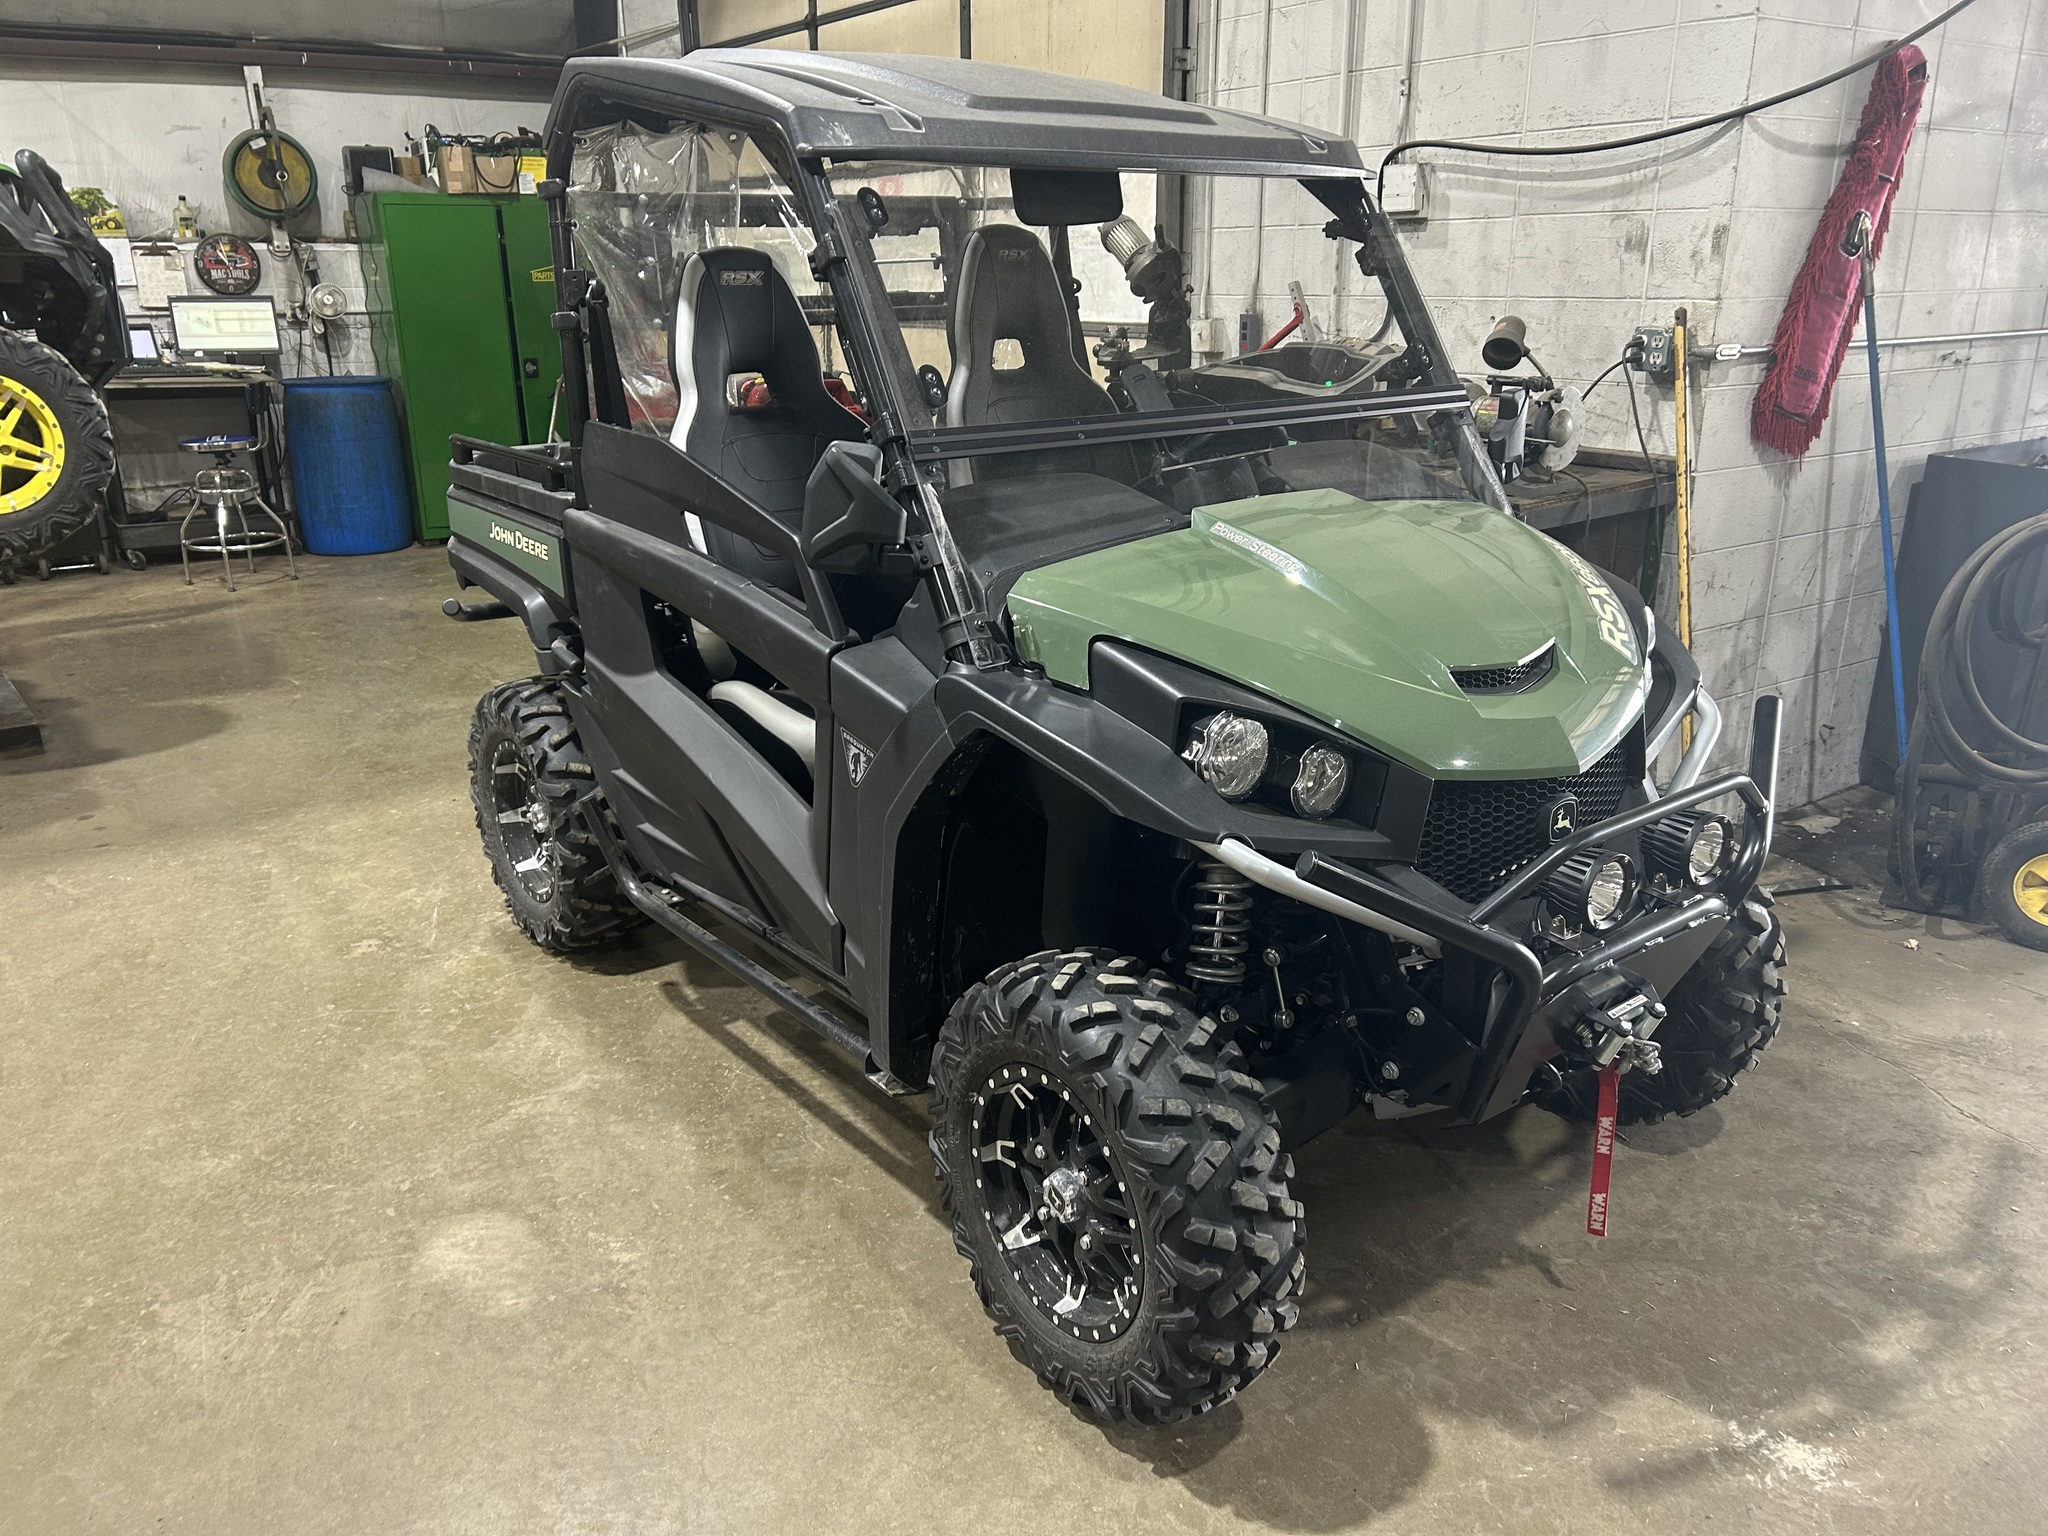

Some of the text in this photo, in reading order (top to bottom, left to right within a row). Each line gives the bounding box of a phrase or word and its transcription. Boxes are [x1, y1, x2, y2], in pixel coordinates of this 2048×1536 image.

[253, 261, 258, 269] 3
[998, 248, 1032, 261] RSX
[210, 269, 250, 280] MAC TOOLS
[720, 270, 765, 286] RSX
[489, 521, 549, 561] JOHN DEERE
[1211, 522, 1303, 574] Power Steering
[843, 731, 875, 759] SASQUATCH
[1596, 1116, 1614, 1155] WARN
[1590, 1192, 1607, 1231] WARN
